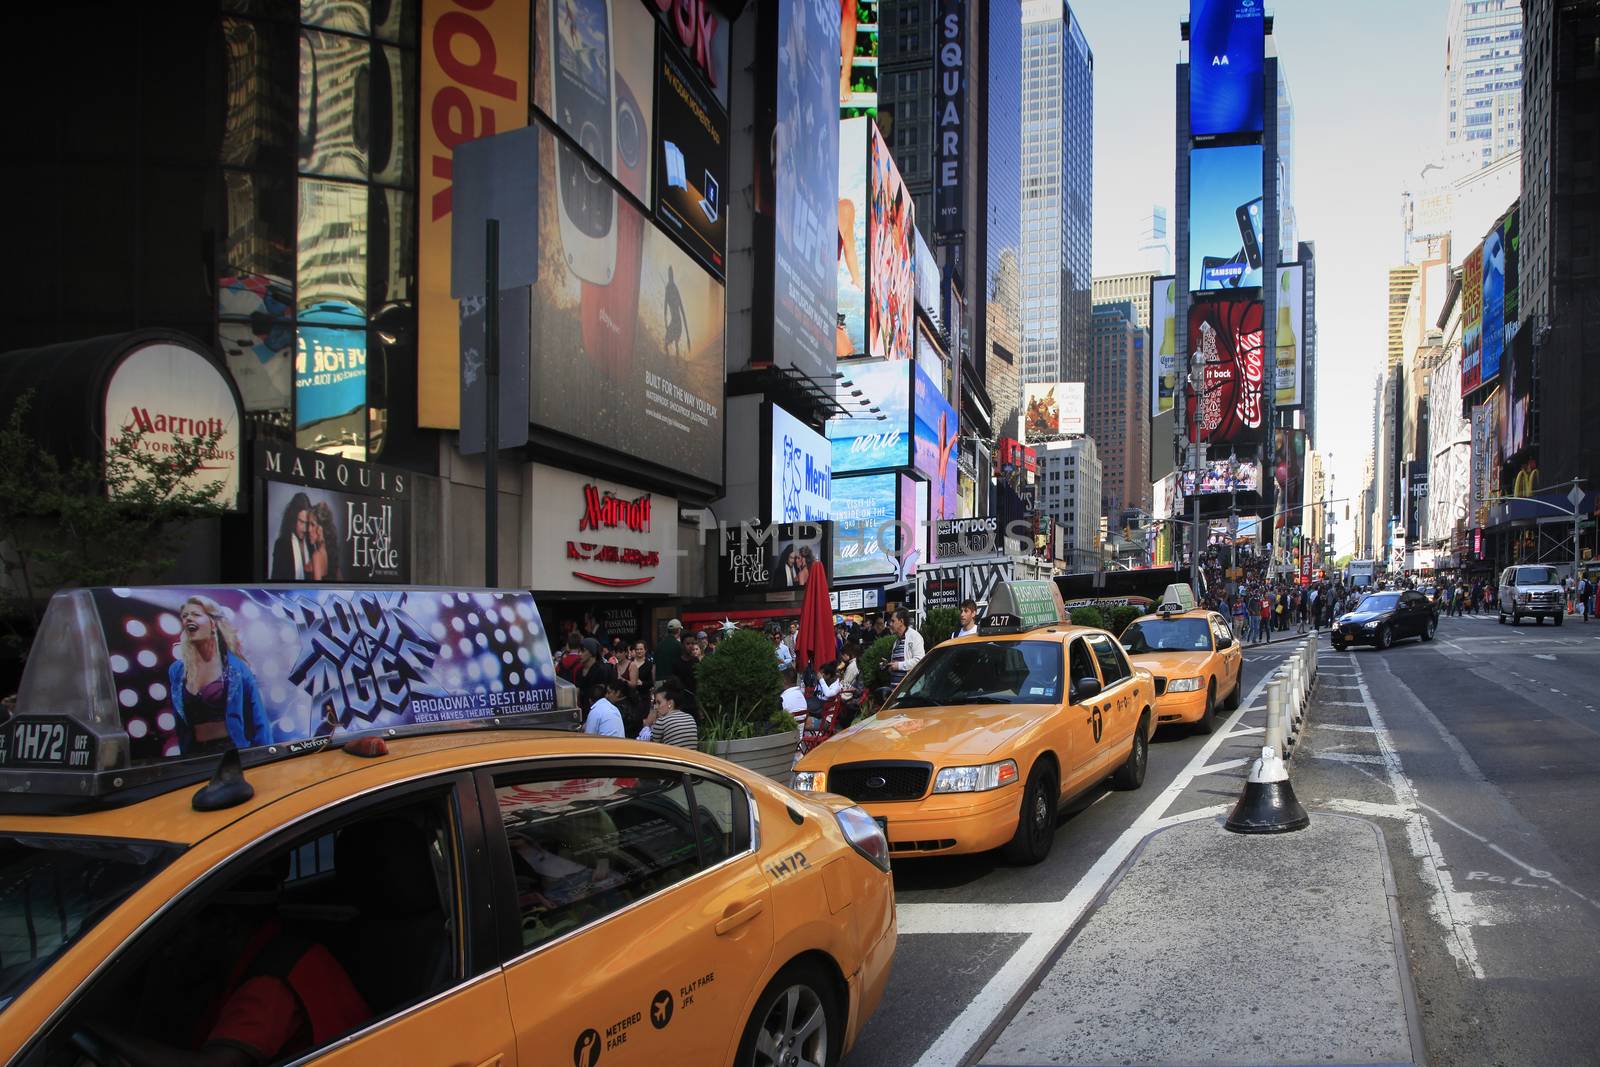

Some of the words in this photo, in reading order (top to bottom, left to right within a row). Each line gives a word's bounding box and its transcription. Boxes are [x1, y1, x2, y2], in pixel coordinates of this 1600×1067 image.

[1212, 55, 1229, 66] AA
[941, 14, 962, 186] SQUARE
[941, 207, 957, 216] NYC
[1211, 267, 1242, 276] SAMSUNG
[1207, 370, 1213, 379] it
[1214, 370, 1231, 378] back
[646, 370, 661, 389] BUILT
[661, 379, 673, 396] FOR
[673, 384, 684, 402] THE
[683, 391, 695, 408] WAY
[696, 398, 706, 413] YOU
[126, 406, 223, 440] Marriott
[110, 437, 139, 450] NW
[144, 441, 176, 453] YORK
[851, 424, 902, 453] aerie
[265, 450, 404, 493] MARQUIS
[579, 483, 651, 533] Marriott
[866, 498, 876, 507] US
[346, 501, 392, 543] Jekyll
[727, 526, 823, 541] MARQUIS
[951, 519, 971, 535] HOT
[971, 517, 997, 532] DOGS
[352, 536, 399, 577] Hyde
[729, 546, 764, 571] Jekyll
[734, 564, 769, 587] Hyde
[927, 597, 946, 605] LOBSTR
[282, 590, 434, 668] ROCK
[990, 615, 1010, 627] 2L77
[352, 634, 377, 658] OF
[302, 640, 447, 729] AGES
[411, 694, 487, 713] BROADWAY'S
[490, 691, 516, 706] BEST
[519, 688, 554, 702] PARTY!
[415, 712, 439, 723] HELEN
[440, 710, 464, 721] HAYES
[465, 707, 495, 719] THEATRE
[16, 724, 65, 760] 1H72
[74, 735, 88, 750] OFF
[69, 751, 90, 766] DUTY
[765, 850, 812, 879] 1H72
[680, 980, 697, 997] FLAT
[697, 972, 715, 988] FARE
[681, 996, 694, 1009] JFK
[606, 1011, 641, 1038] METERED
[606, 1032, 627, 1051] FARE
